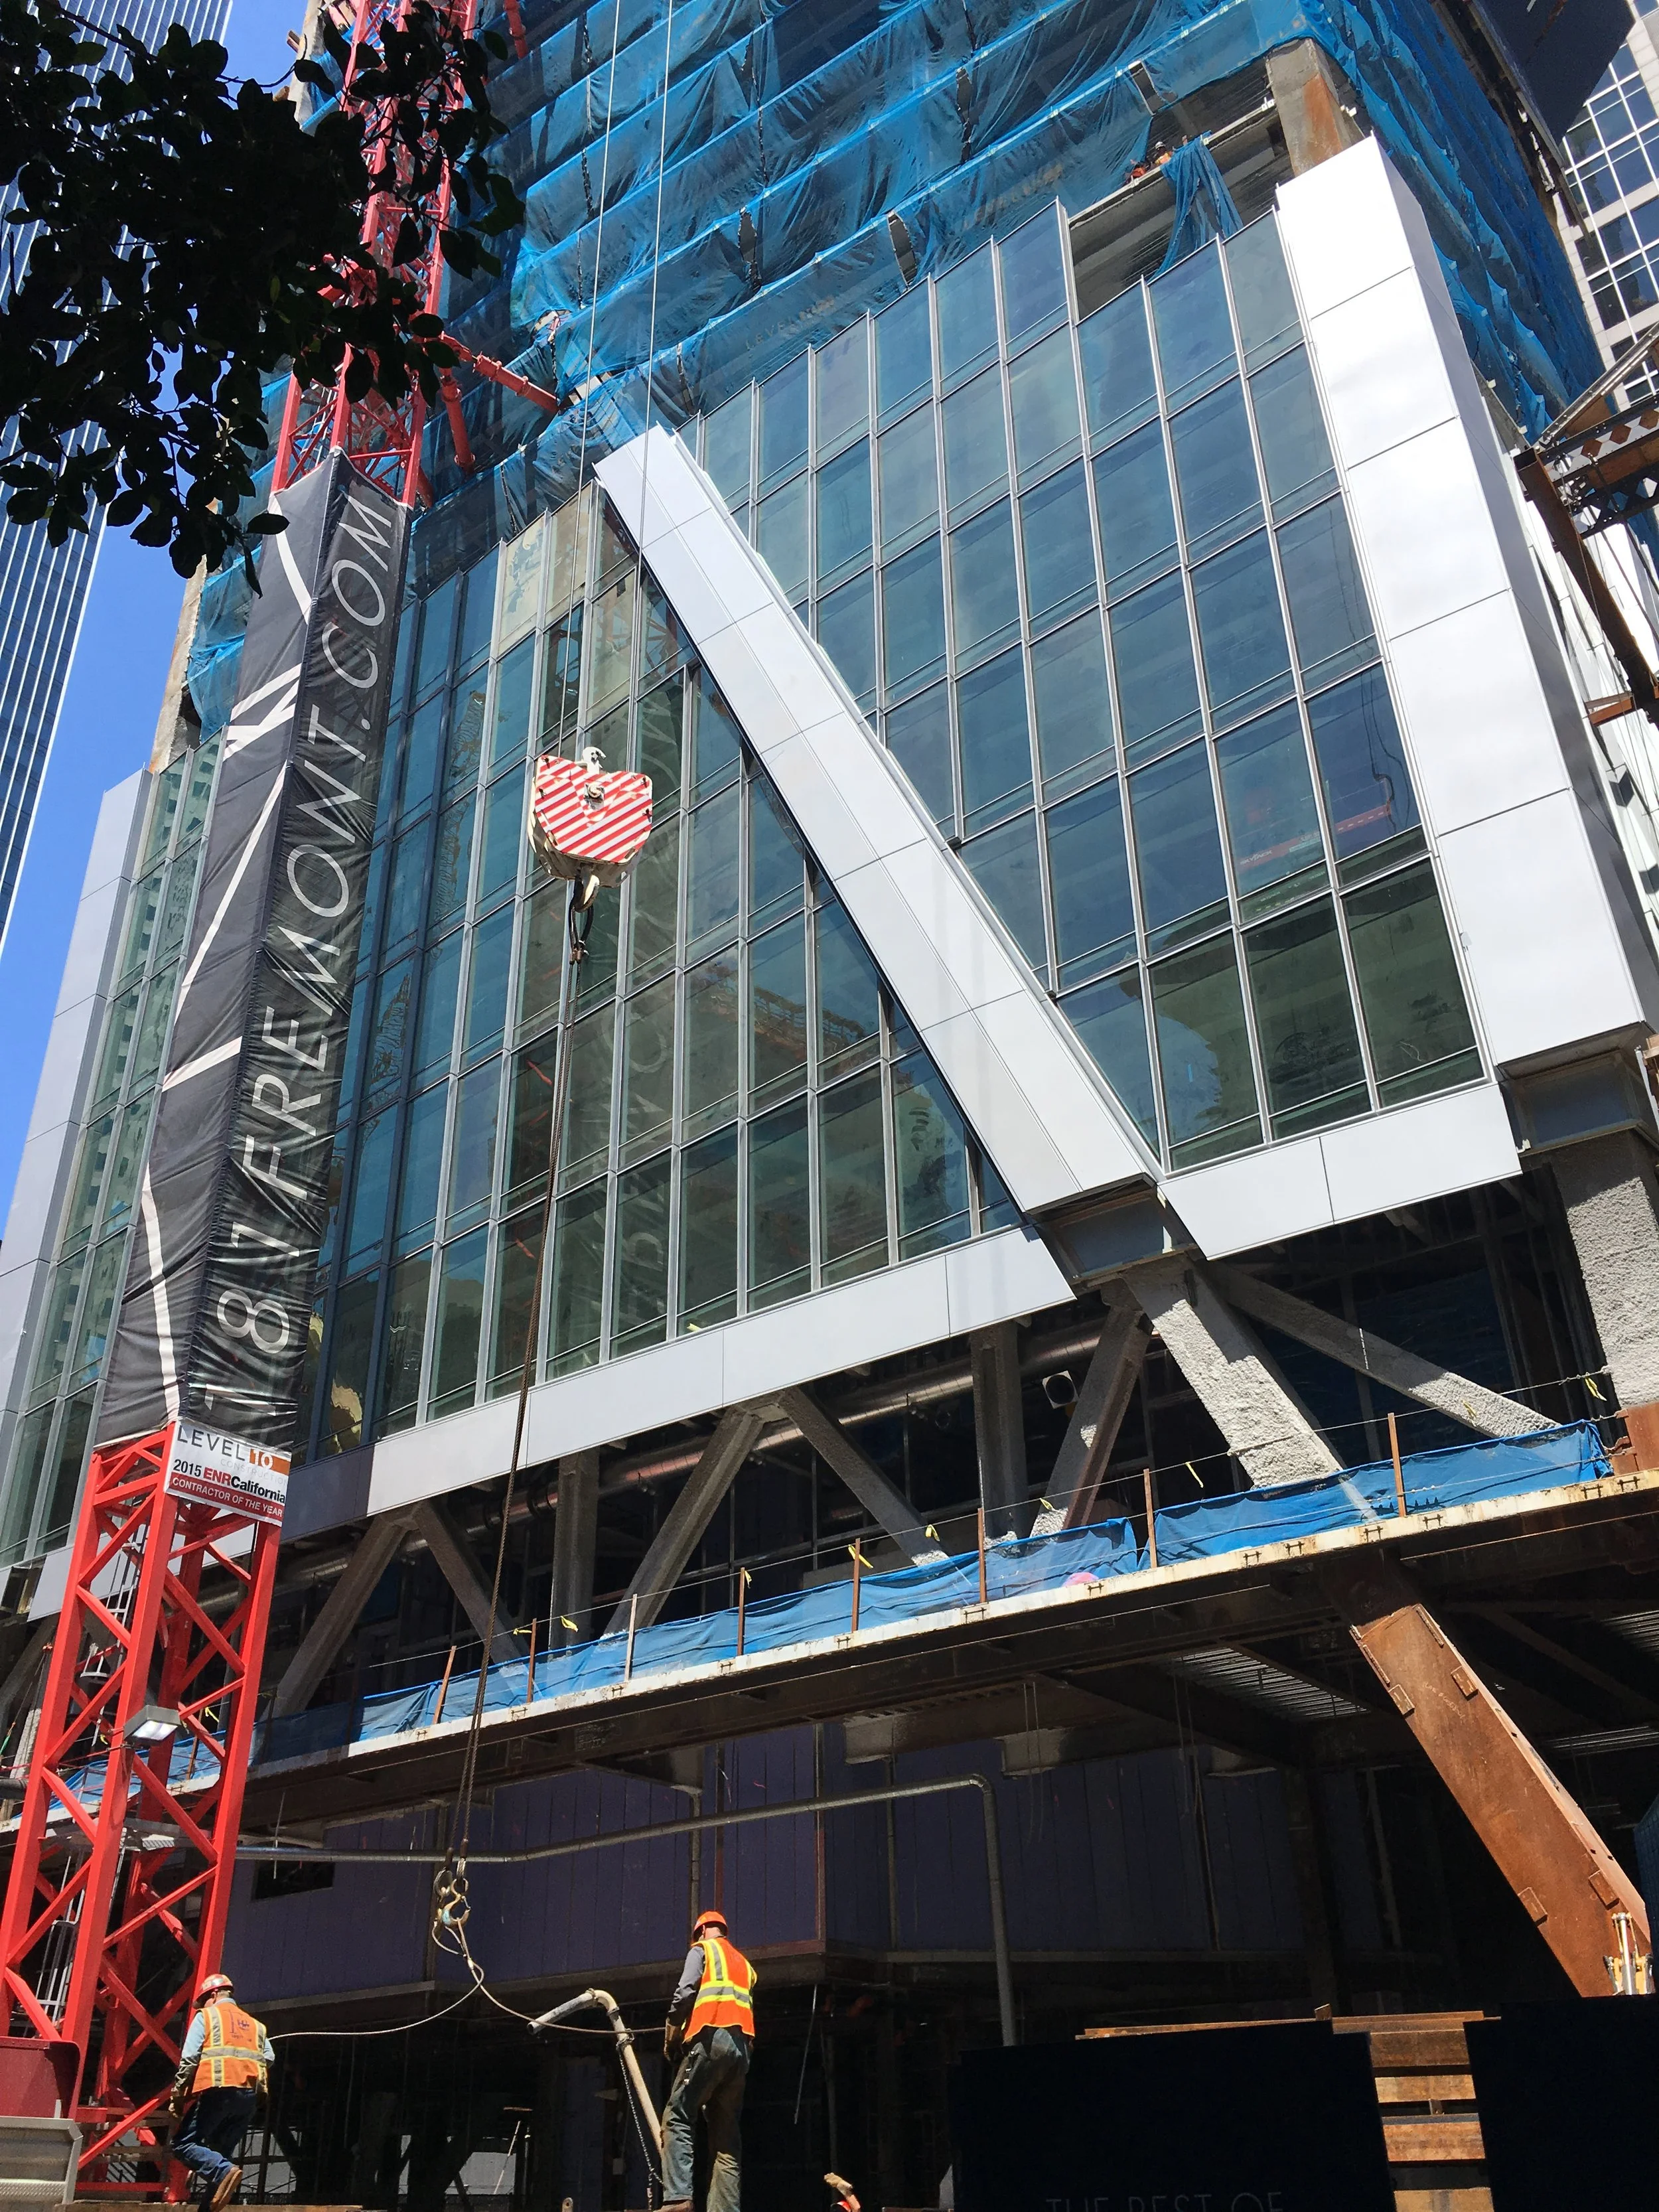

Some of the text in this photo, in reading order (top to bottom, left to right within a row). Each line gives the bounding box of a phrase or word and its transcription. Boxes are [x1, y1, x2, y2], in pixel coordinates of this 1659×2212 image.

[173, 1459, 202, 1477] 2015
[177, 1426, 274, 1470] LEVEL 10
[172, 1477, 283, 1517] CONTRACTOR OF THE YEAR
